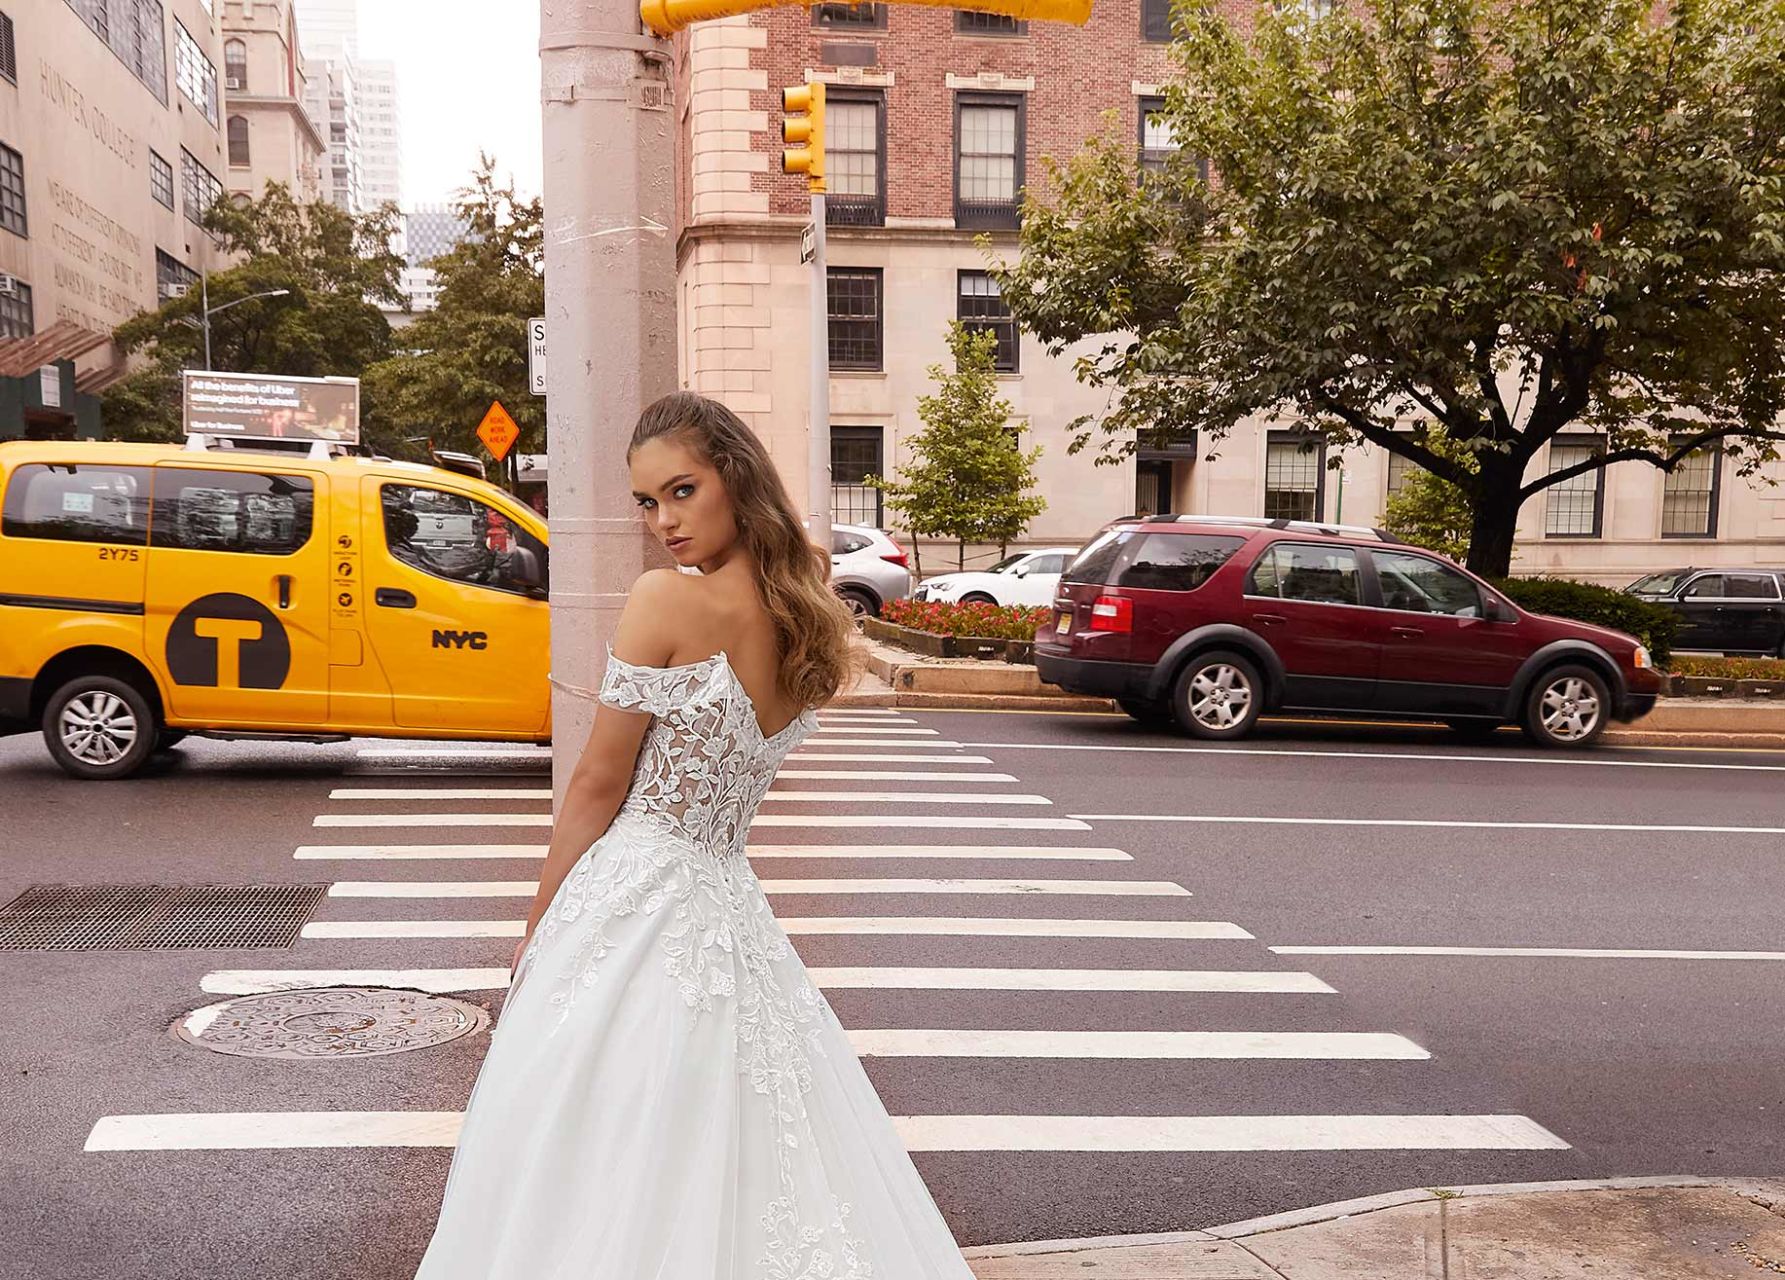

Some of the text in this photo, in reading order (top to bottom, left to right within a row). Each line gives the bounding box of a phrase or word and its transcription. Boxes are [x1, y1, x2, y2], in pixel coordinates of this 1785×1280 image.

[39, 57, 136, 169] HUNTER COLLEGE
[84, 202, 115, 241] DIFFERENT
[115, 223, 141, 257] OPINIONS
[61, 226, 96, 264] DIFFERENT
[120, 260, 132, 285] BUT
[133, 268, 143, 294] WE
[55, 262, 81, 295] ALWAYS
[191, 380, 296, 395] All the benefits of Uber
[191, 393, 300, 407] reimagined for business
[489, 416, 504, 424] ROAD
[489, 435, 508, 443] AHEAD
[98, 547, 140, 562] 2Y75
[431, 629, 488, 650] NYC
[194, 616, 263, 689] T
